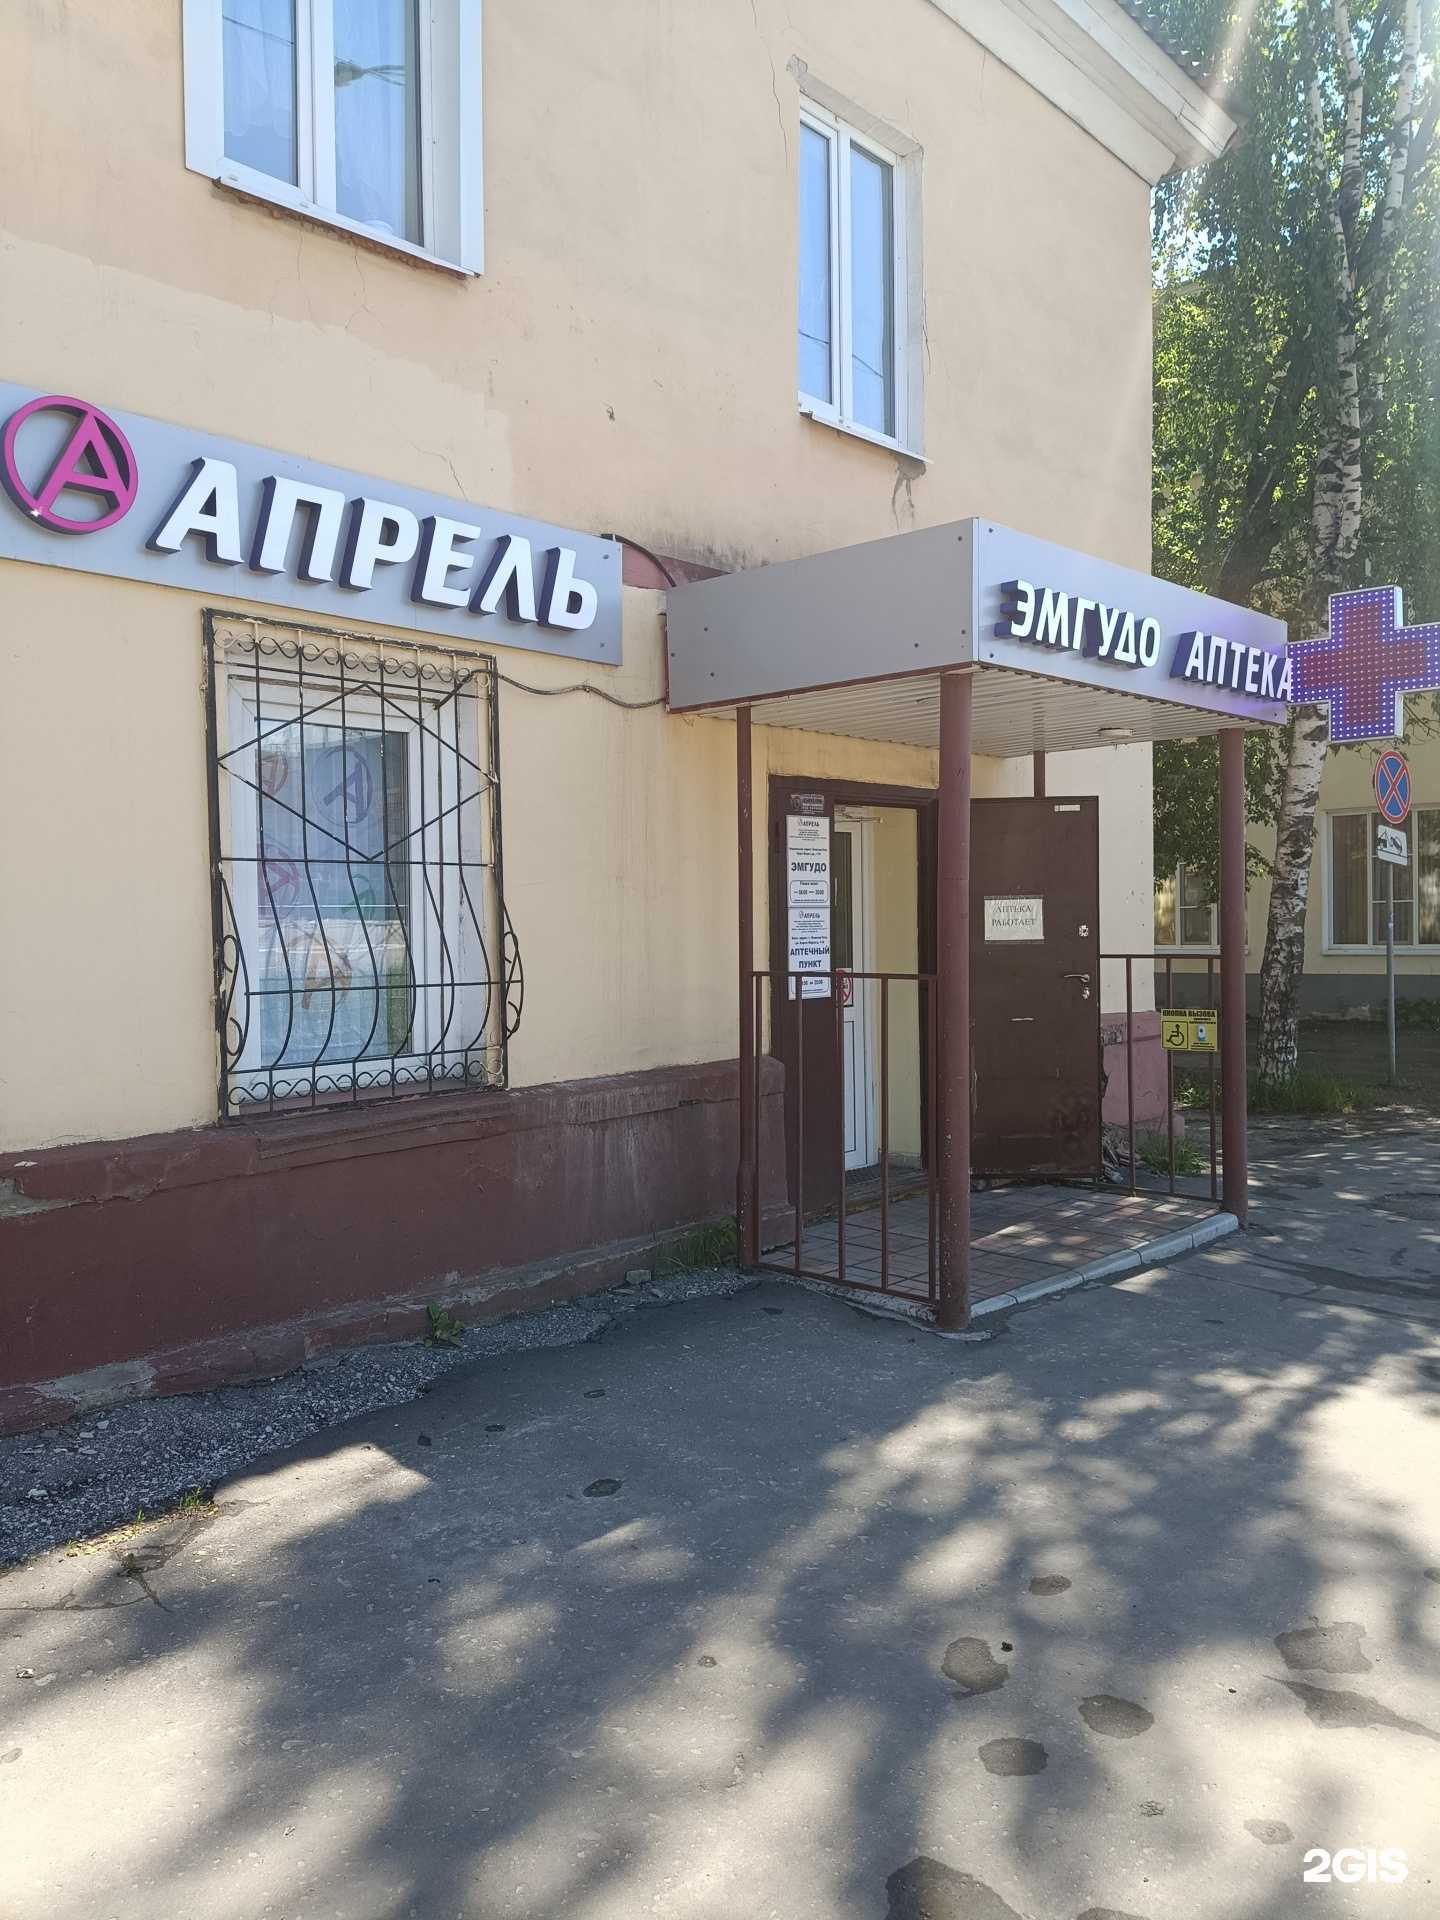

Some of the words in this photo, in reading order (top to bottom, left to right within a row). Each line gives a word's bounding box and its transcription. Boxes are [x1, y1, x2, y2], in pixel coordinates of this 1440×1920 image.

[149, 456, 599, 631] АПРЕЛЬ
[1002, 579, 1161, 667] ЭМГУДО
[1182, 631, 1293, 702] АПТЕКА
[791, 862, 827, 874] ЭМГУДО
[993, 904, 1032, 913] АПТЕКА
[992, 918, 1036, 928] РАБОТАЕТ
[790, 944, 830, 956] АПТЕЧНЫЙ
[799, 960, 822, 968] ПУНКТ
